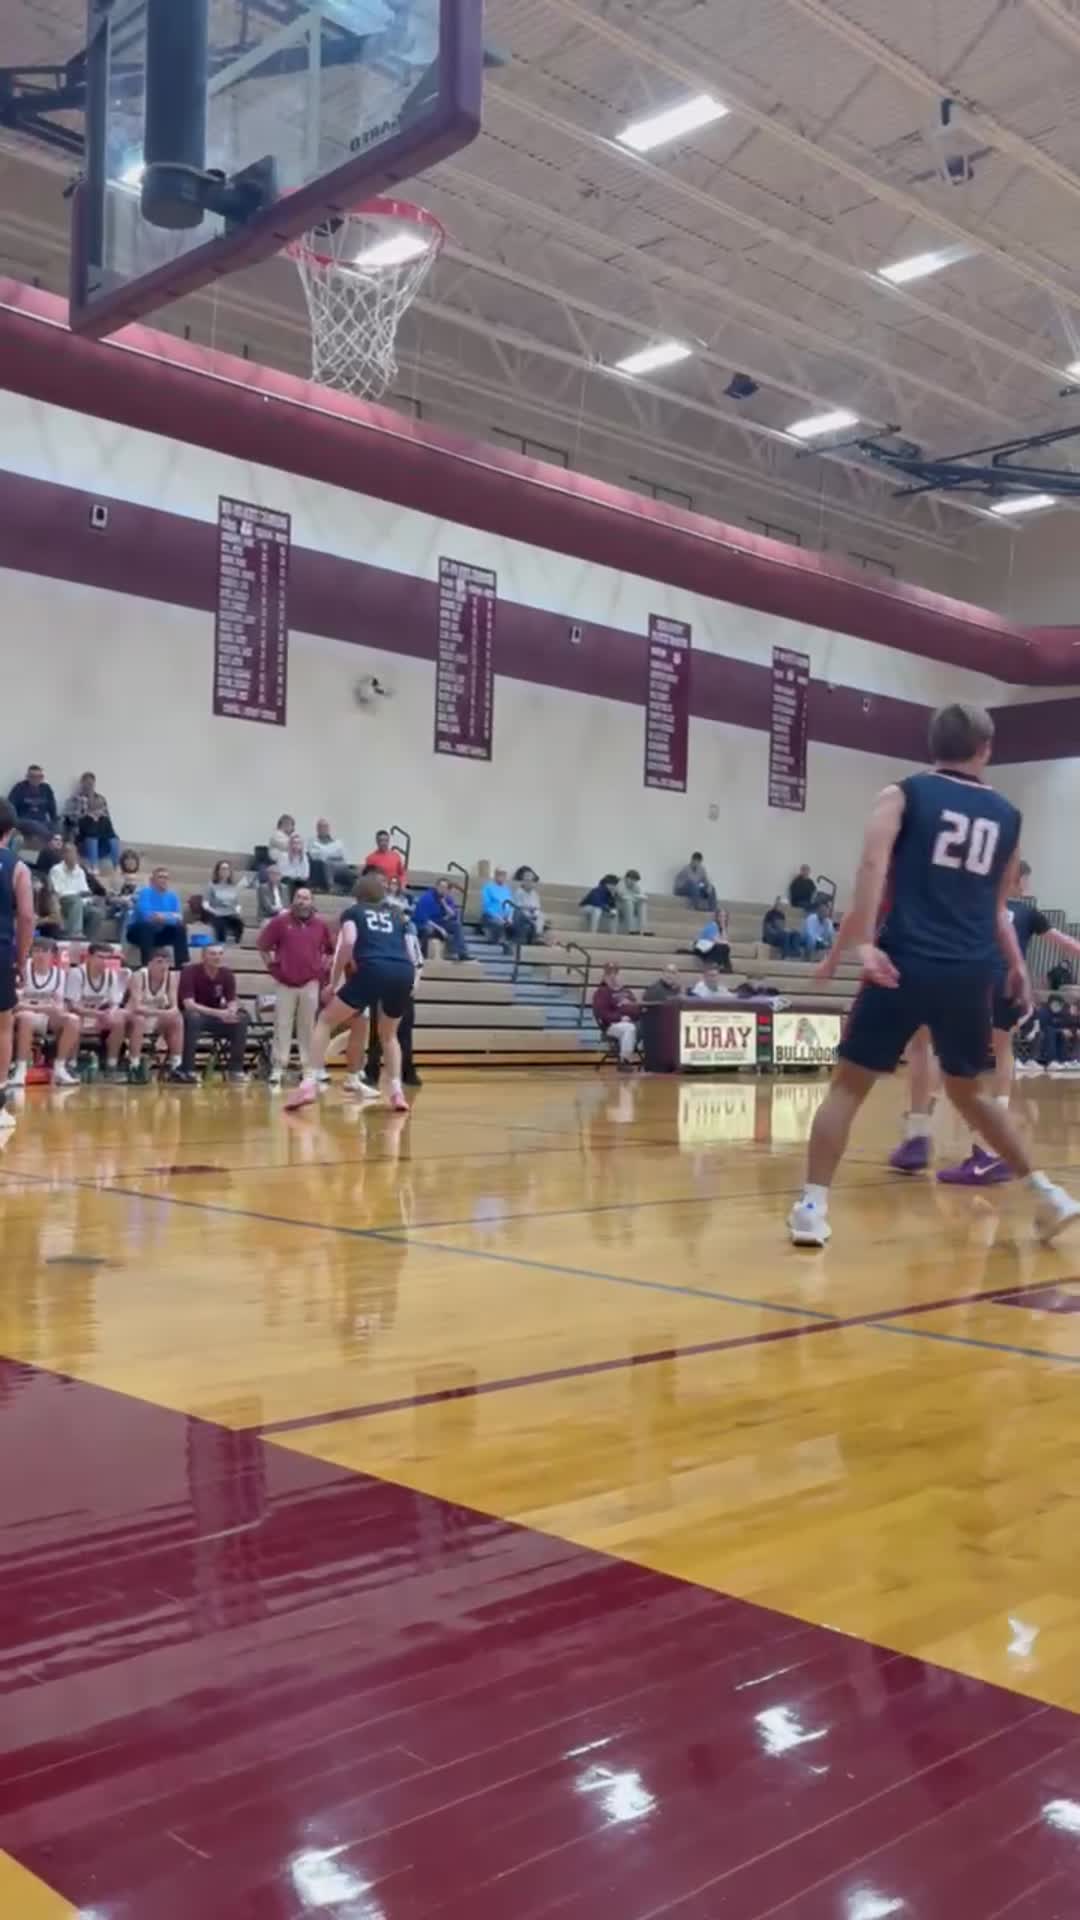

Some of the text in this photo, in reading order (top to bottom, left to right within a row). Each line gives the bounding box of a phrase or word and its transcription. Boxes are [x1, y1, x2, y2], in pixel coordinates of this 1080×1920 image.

[932, 808, 999, 875] 20
[364, 909, 393, 934] 25
[685, 1025, 752, 1049] LURAY
